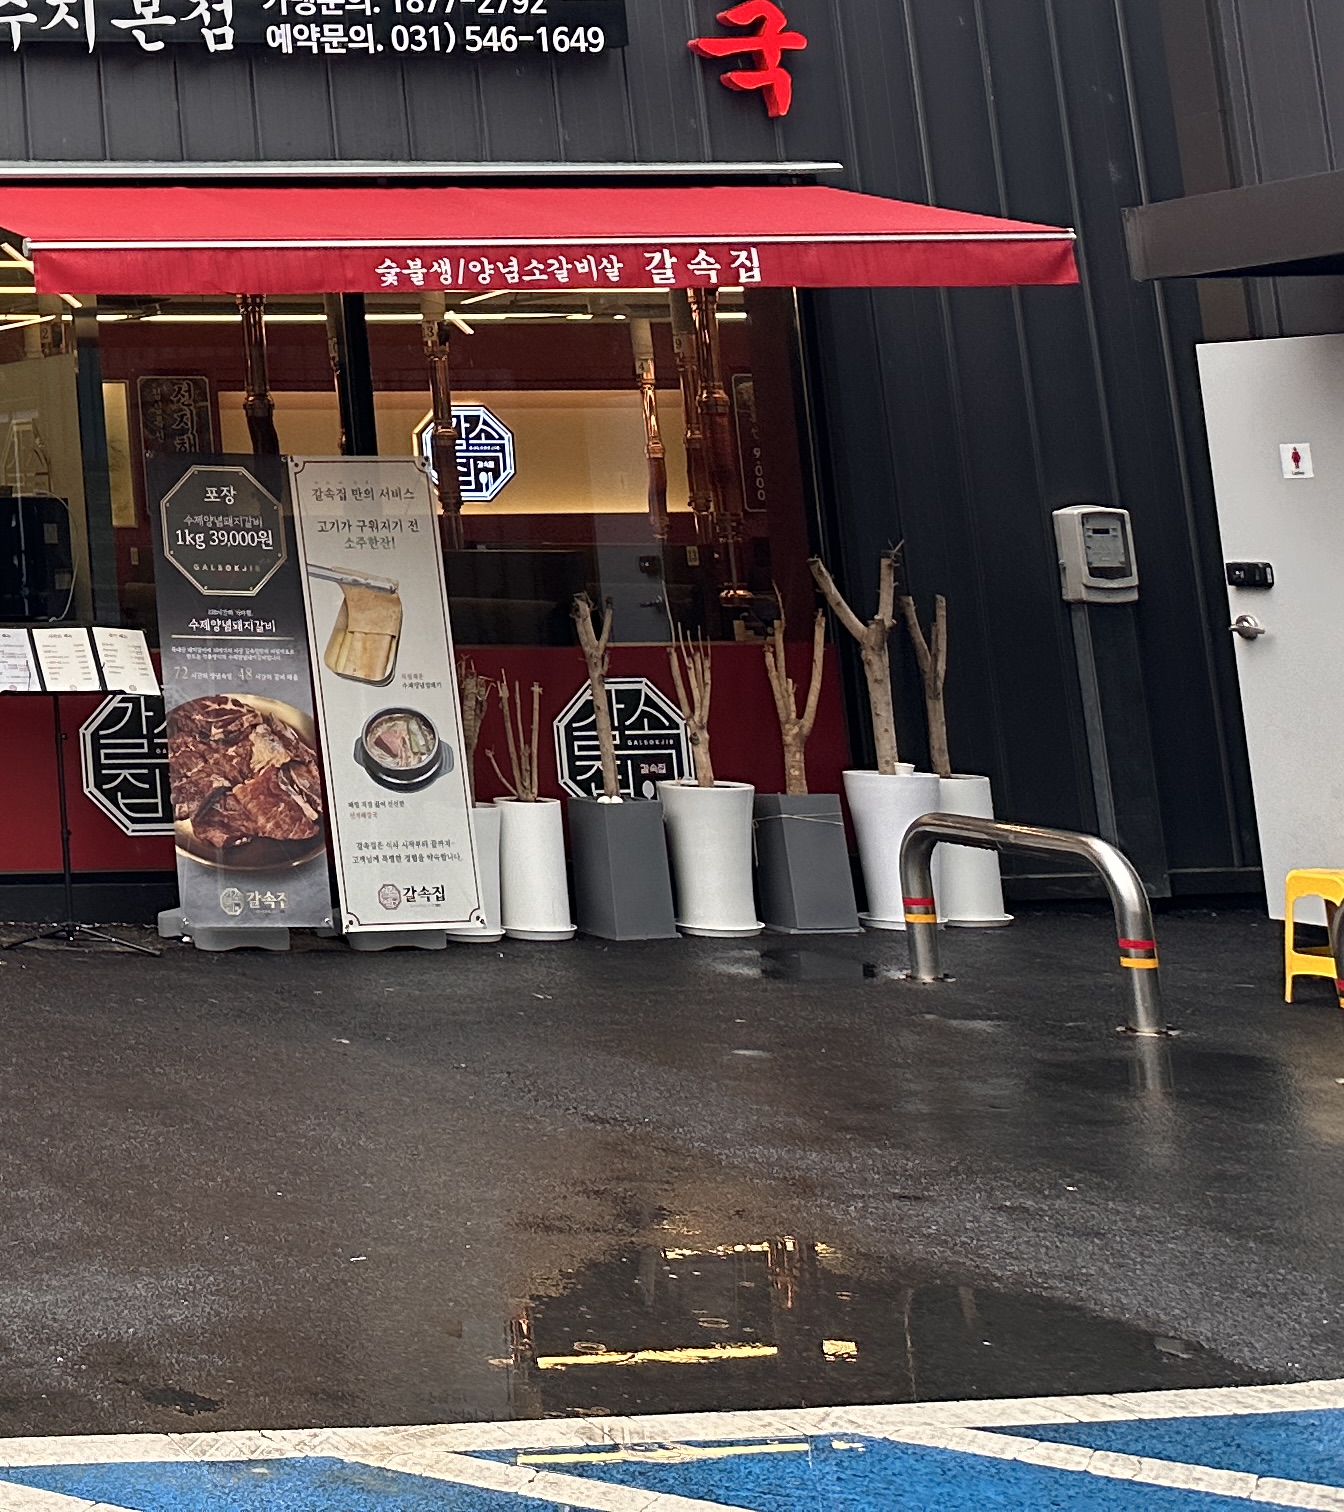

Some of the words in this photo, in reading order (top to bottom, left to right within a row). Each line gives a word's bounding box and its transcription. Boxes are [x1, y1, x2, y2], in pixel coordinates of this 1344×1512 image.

[391, 26, 456, 56] 031)
[466, 26, 605, 56] 546-1649
[374, 253, 624, 287] 숯불생/양념소갈비살
[643, 248, 762, 285] 갈속집
[204, 485, 237, 504] 포장
[312, 487, 347, 501] 갈속집
[352, 488, 374, 501] 만의
[380, 487, 415, 500] 서비스
[317, 519, 352, 533] 고기가
[356, 519, 403, 533] 구워지기
[407, 520, 420, 533] 전
[176, 530, 206, 550] 1kg
[209, 530, 273, 550] 39,000원
[345, 536, 395, 550] 소주한잔!
[188, 618, 276, 633] 수제양념돼지갈비
[174, 666, 189, 680] 72
[238, 667, 252, 680] 48
[246, 891, 289, 909] 갈속집
[403, 884, 446, 902] 갈속집
